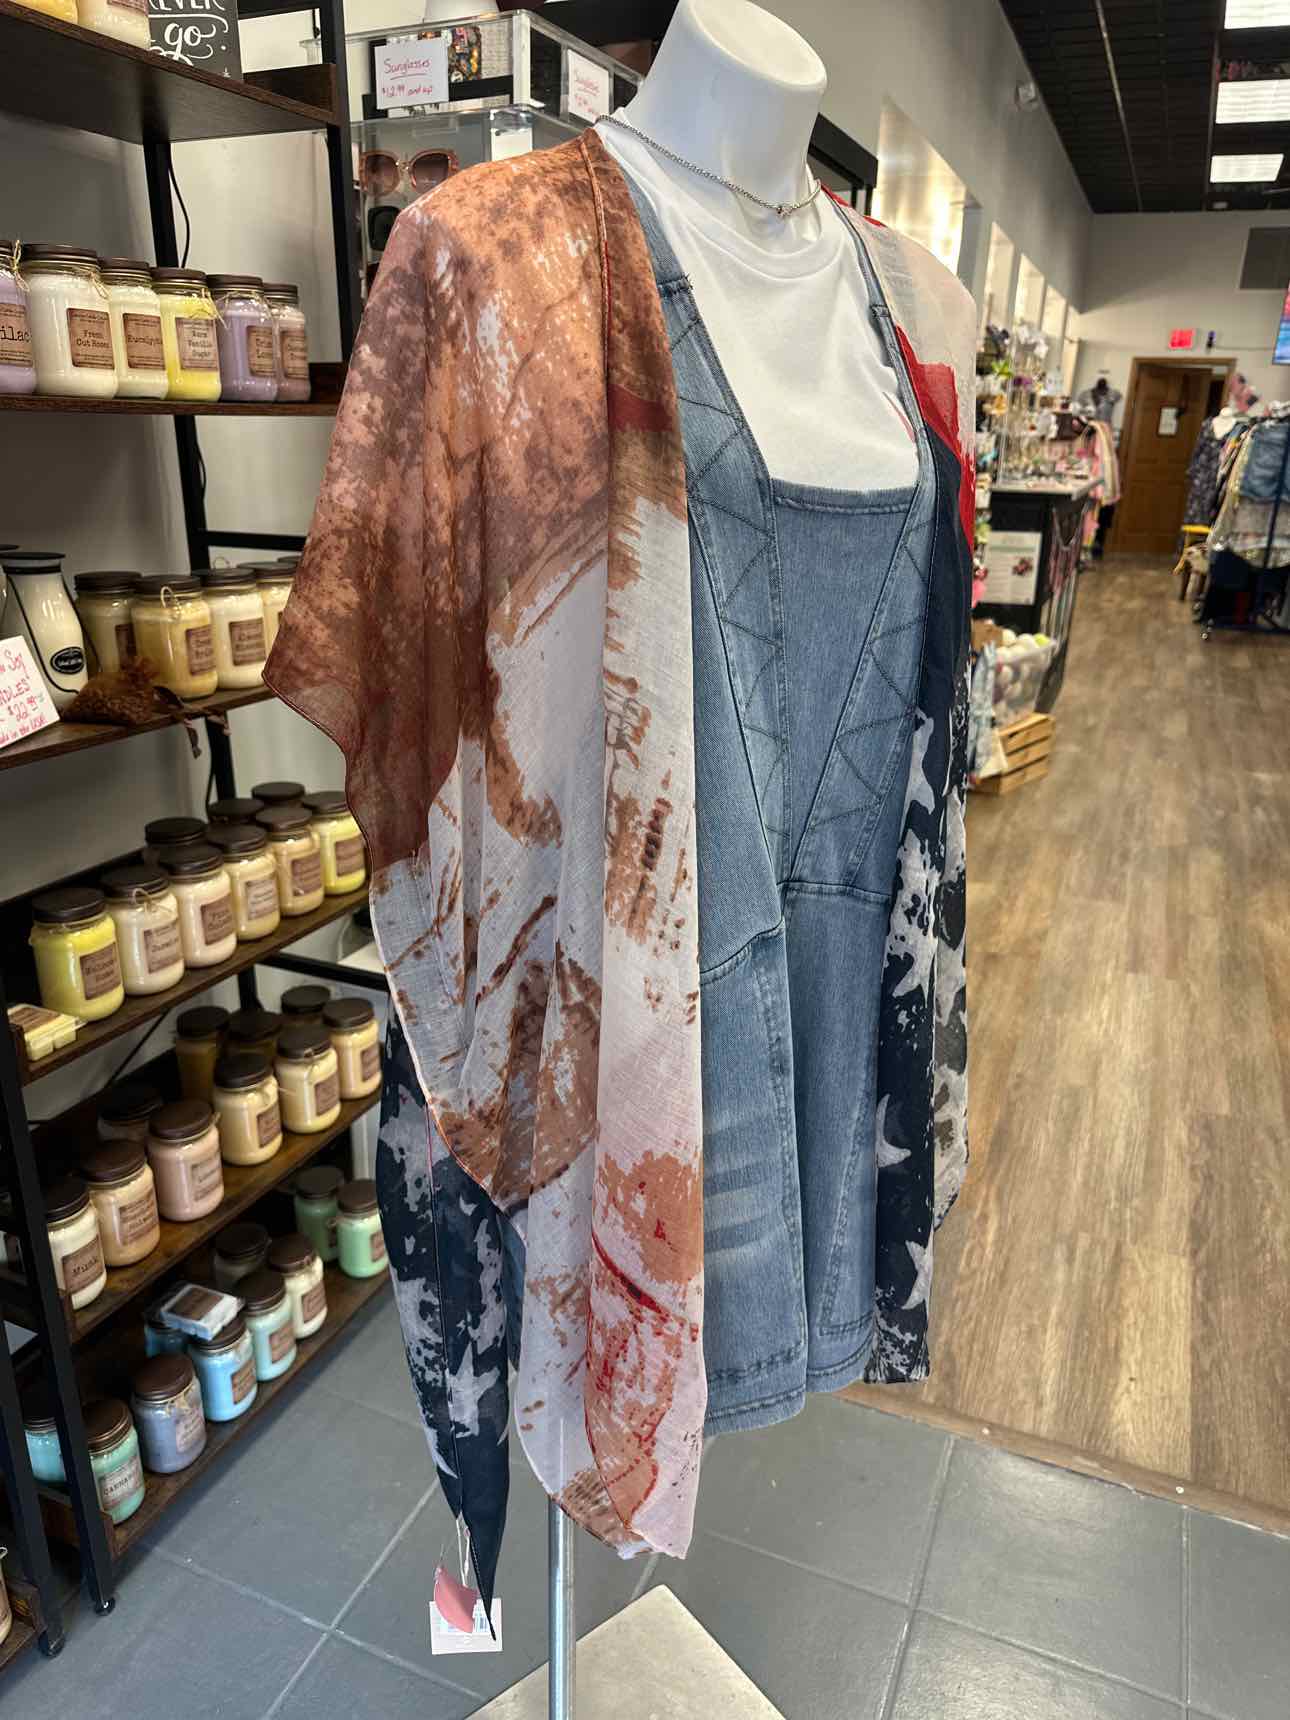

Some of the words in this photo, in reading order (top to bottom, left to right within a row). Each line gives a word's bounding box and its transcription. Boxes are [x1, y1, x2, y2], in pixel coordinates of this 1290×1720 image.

[164, 22, 216, 60] go
[384, 58, 431, 74] Sunglasses
[0, 325, 31, 344] ilac
[0, 678, 31, 706] NDLES
